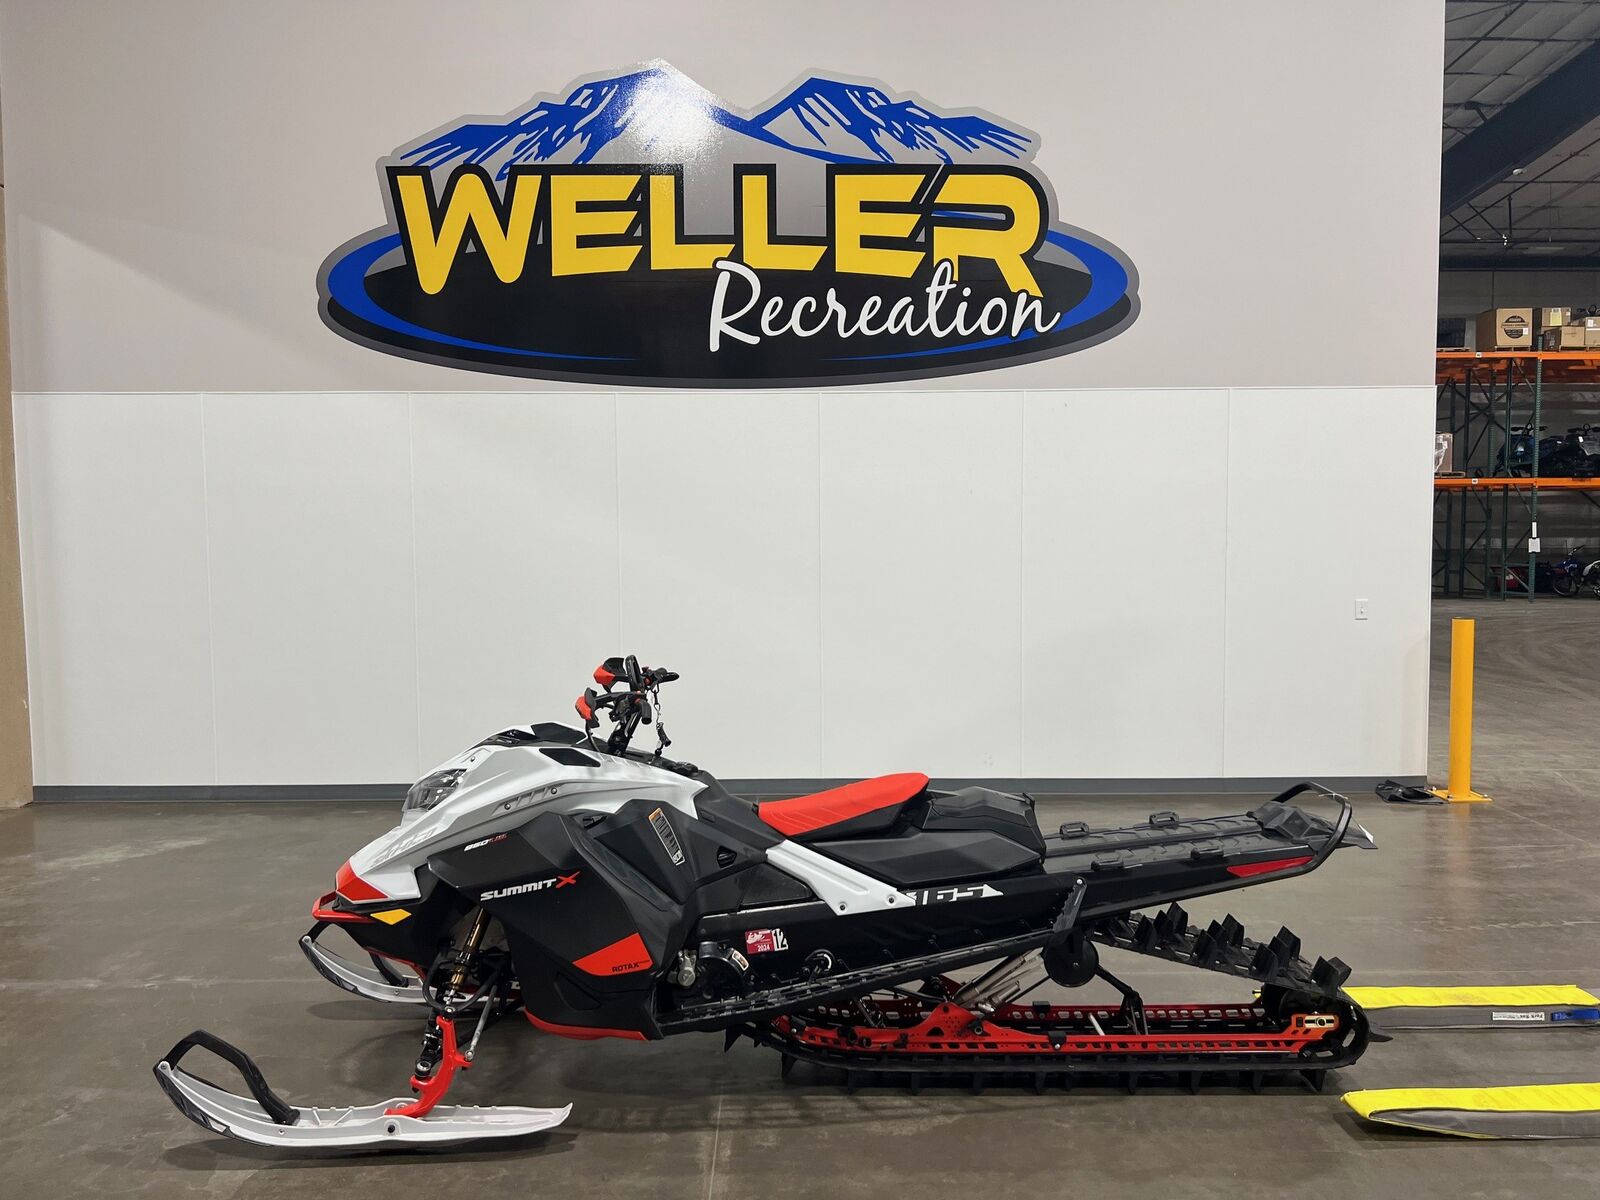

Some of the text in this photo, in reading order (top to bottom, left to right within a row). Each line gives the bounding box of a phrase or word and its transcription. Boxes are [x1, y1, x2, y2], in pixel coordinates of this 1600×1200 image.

[395, 171, 1045, 297] WELLER
[709, 260, 1060, 353] Recreation
[480, 878, 557, 902] SUMMIT
[757, 944, 770, 952] 2024
[774, 929, 787, 949] 12
[611, 962, 640, 973] ROTAX
